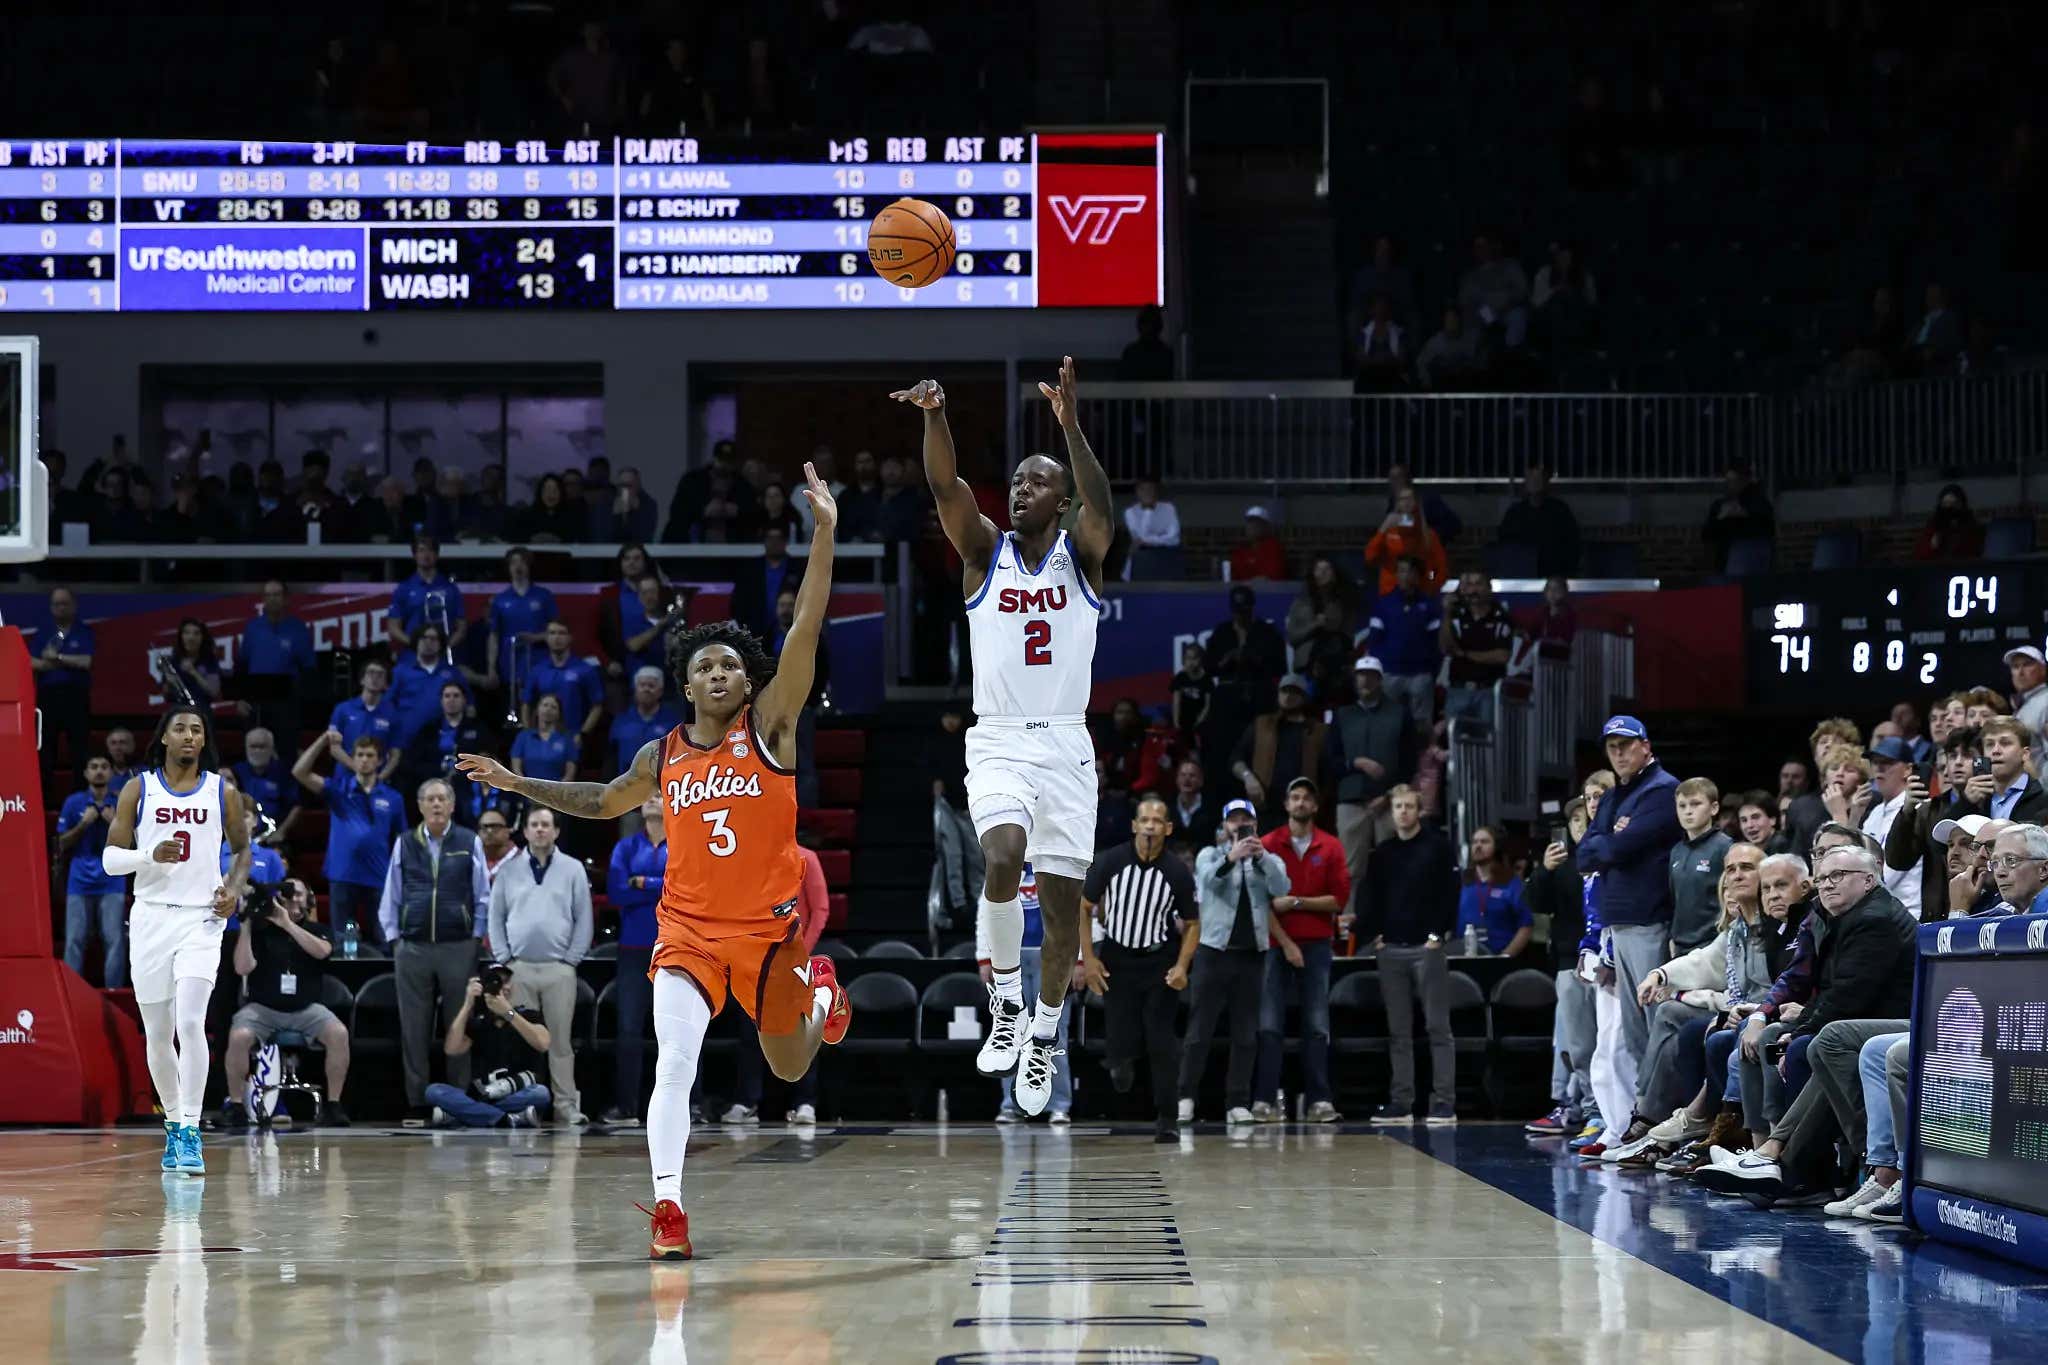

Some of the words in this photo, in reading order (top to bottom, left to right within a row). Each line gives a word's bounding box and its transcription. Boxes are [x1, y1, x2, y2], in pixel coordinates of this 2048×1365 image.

[30, 142, 69, 166] AST
[84, 142, 108, 166] PF
[312, 142, 357, 164] 3-PT
[406, 142, 427, 164] FT
[464, 141, 501, 163] REB
[515, 141, 550, 164] STL
[563, 140, 600, 163] AST
[624, 138, 698, 164] PLAYER
[887, 138, 927, 162] REB
[944, 137, 985, 162] AST
[1000, 137, 1024, 162] PF
[88, 172, 104, 192] 2
[142, 172, 198, 192] SMU
[524, 171, 540, 191] 5
[567, 171, 598, 191] 13
[626, 170, 651, 189] #1
[657, 170, 730, 189] LAWAL
[833, 169, 865, 189] 10
[956, 169, 973, 189] 0
[1003, 169, 1020, 189] 0
[40, 200, 57, 221] 6
[88, 200, 104, 221] 3
[154, 200, 185, 220] VT
[218, 200, 285, 221] 28-61
[308, 200, 361, 220] 9-28
[383, 199, 450, 220] 11-18
[466, 199, 499, 220] 36
[524, 199, 540, 220] 9
[566, 199, 598, 220] 15
[626, 199, 653, 218] #2
[657, 199, 740, 218] SCHUTT
[832, 197, 865, 218] 15
[956, 197, 973, 217] 0
[1003, 197, 1020, 217] 2
[1048, 195, 1147, 245] VT
[41, 229, 57, 249] 0
[87, 229, 103, 249] 4
[626, 227, 653, 245] #3
[657, 227, 774, 246] HAMMOND
[834, 226, 862, 246] 11
[1004, 225, 1019, 246] 1
[382, 239, 458, 264] MICH
[516, 238, 555, 263] 24
[41, 257, 55, 278] 1
[87, 257, 102, 278] 1
[577, 254, 596, 282] 1
[625, 255, 667, 274] #13
[671, 254, 801, 275] HANSBERRY
[840, 254, 858, 275] 6
[956, 253, 974, 274] 0
[1003, 253, 1021, 274] 4
[207, 274, 285, 294] Medical
[288, 274, 356, 294] Center
[382, 274, 470, 299] WASH
[517, 274, 555, 298] 13
[626, 283, 666, 302] #17
[834, 282, 865, 303] 10
[1004, 282, 1019, 302] 1
[41, 286, 55, 307] 1
[87, 286, 102, 307] 1
[998, 584, 1067, 613] SMU
[1948, 576, 1997, 618] 0.4
[1024, 620, 1052, 666] 2
[1771, 634, 1810, 673] 74
[1852, 642, 1870, 673] 8
[1887, 640, 1904, 671] 0
[1920, 653, 1938, 684] 2
[1026, 721, 1049, 730] SMU
[667, 764, 762, 816] Hokies
[155, 807, 208, 825] SMU
[701, 807, 738, 858] 3
